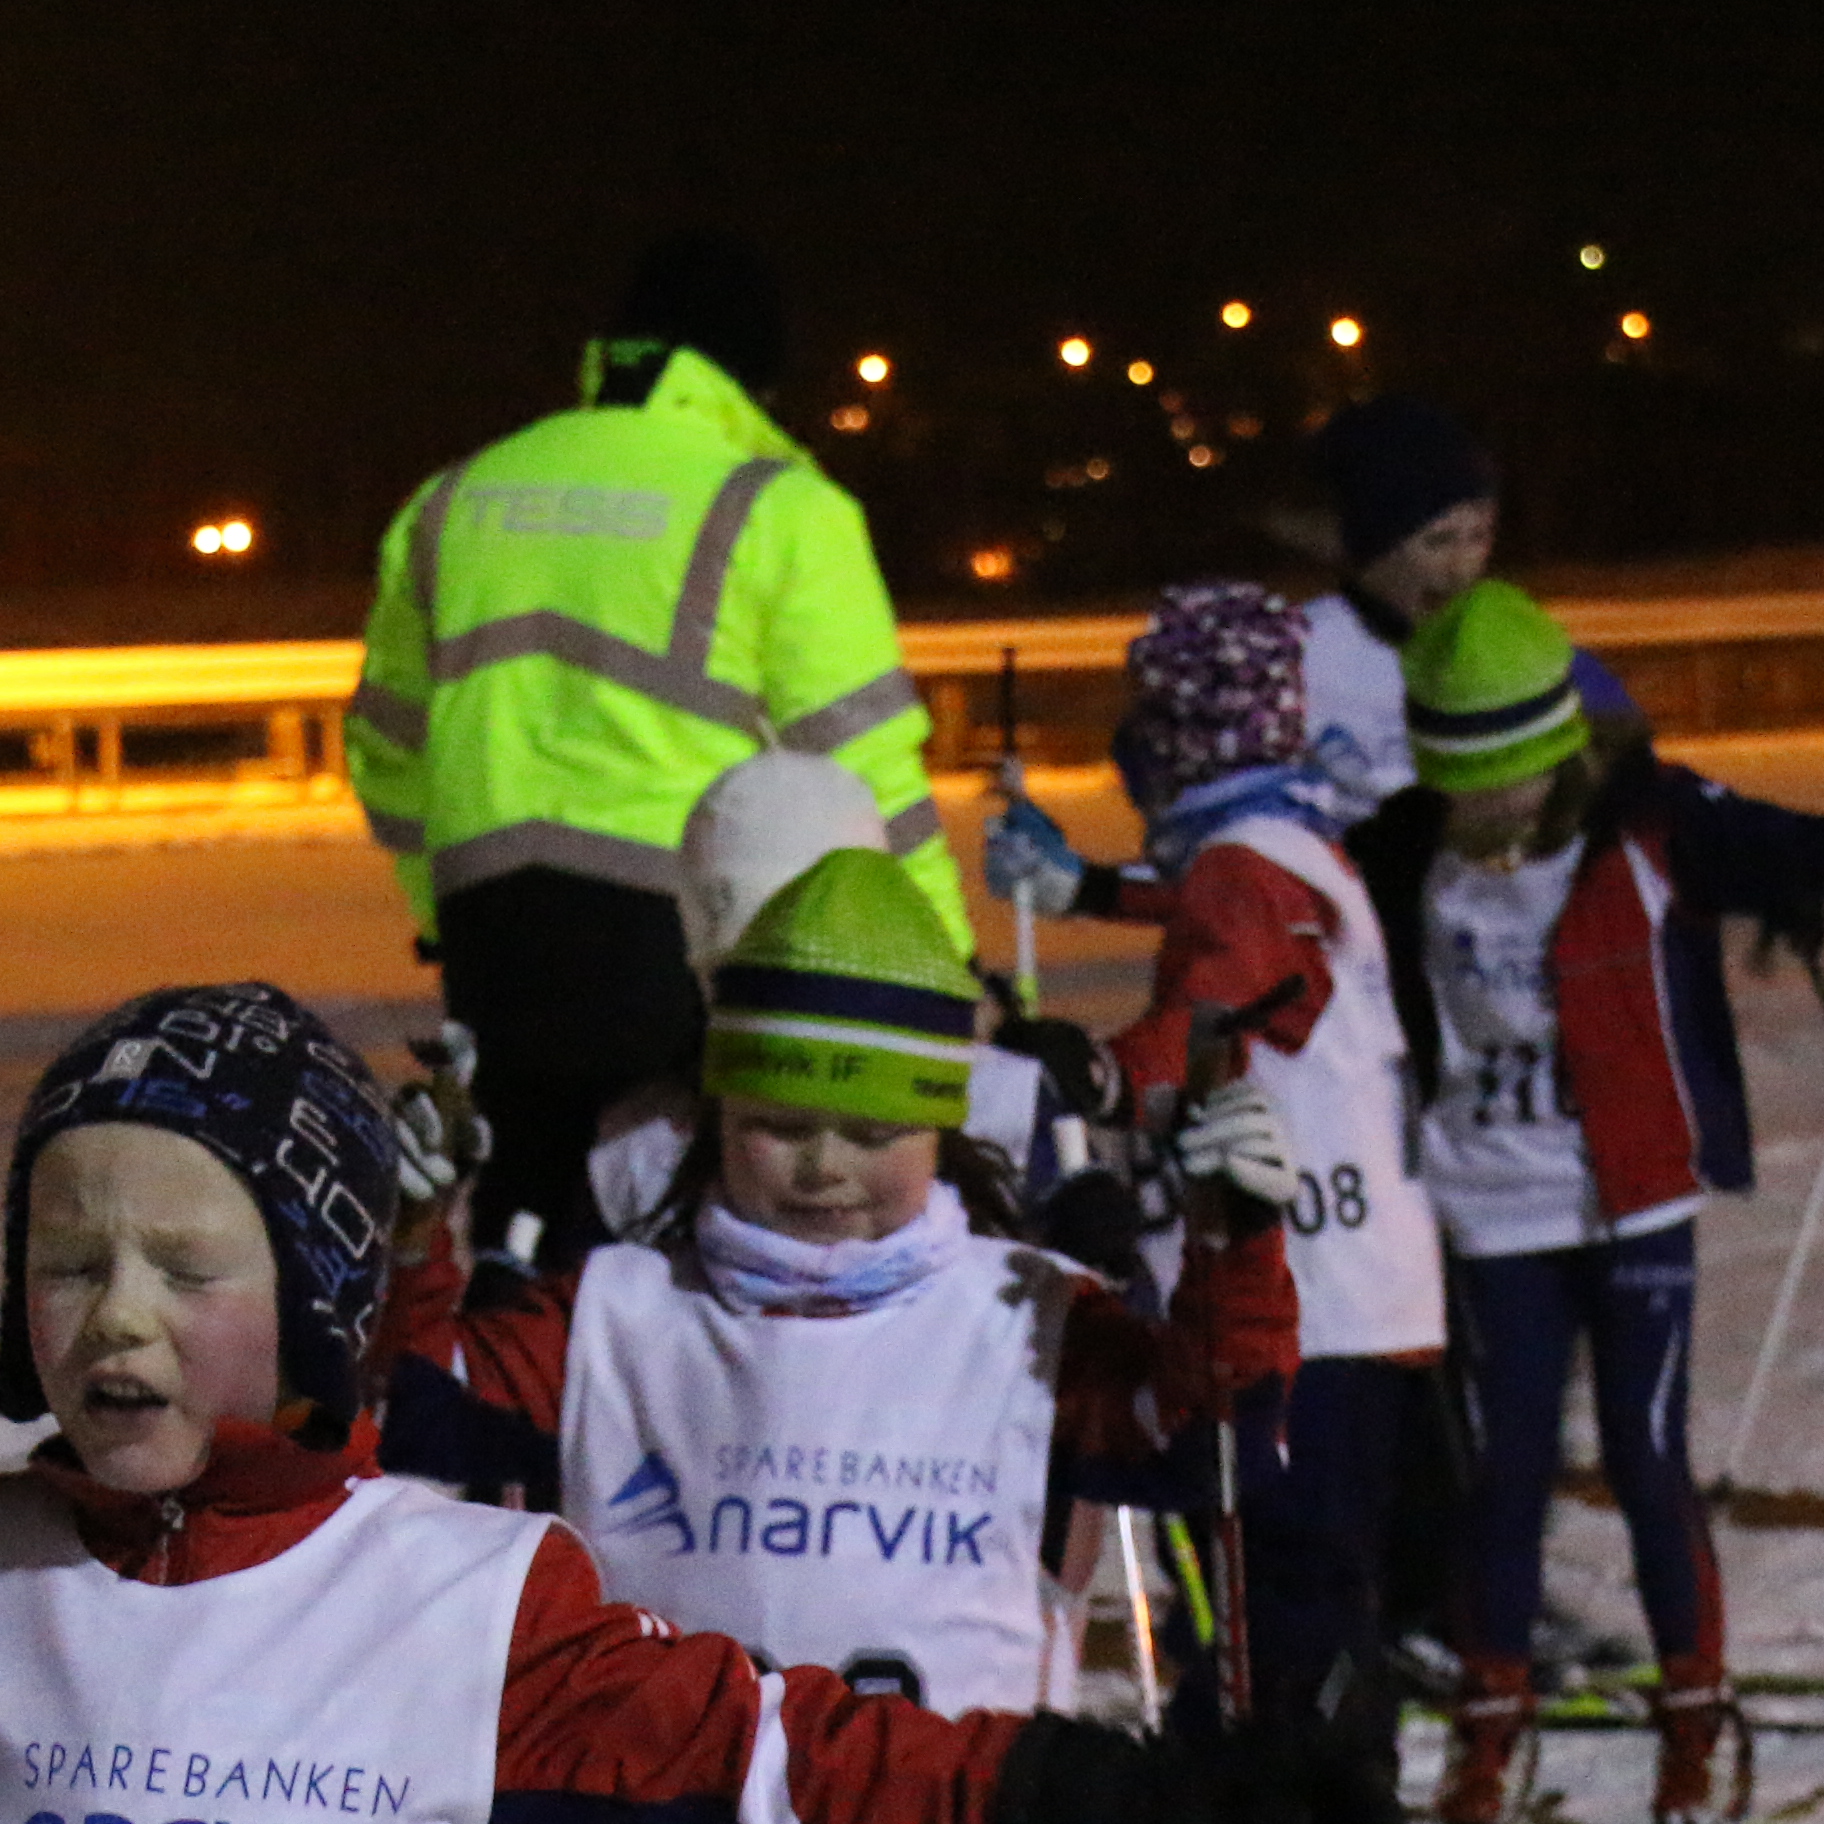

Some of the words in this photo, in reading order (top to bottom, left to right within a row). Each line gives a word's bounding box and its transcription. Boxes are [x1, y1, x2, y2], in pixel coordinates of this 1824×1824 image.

[464, 484, 671, 540] TESS
[713, 1442, 1001, 1498] SPAREBANKEN
[24, 1742, 413, 1816] SPAREBANKEN
